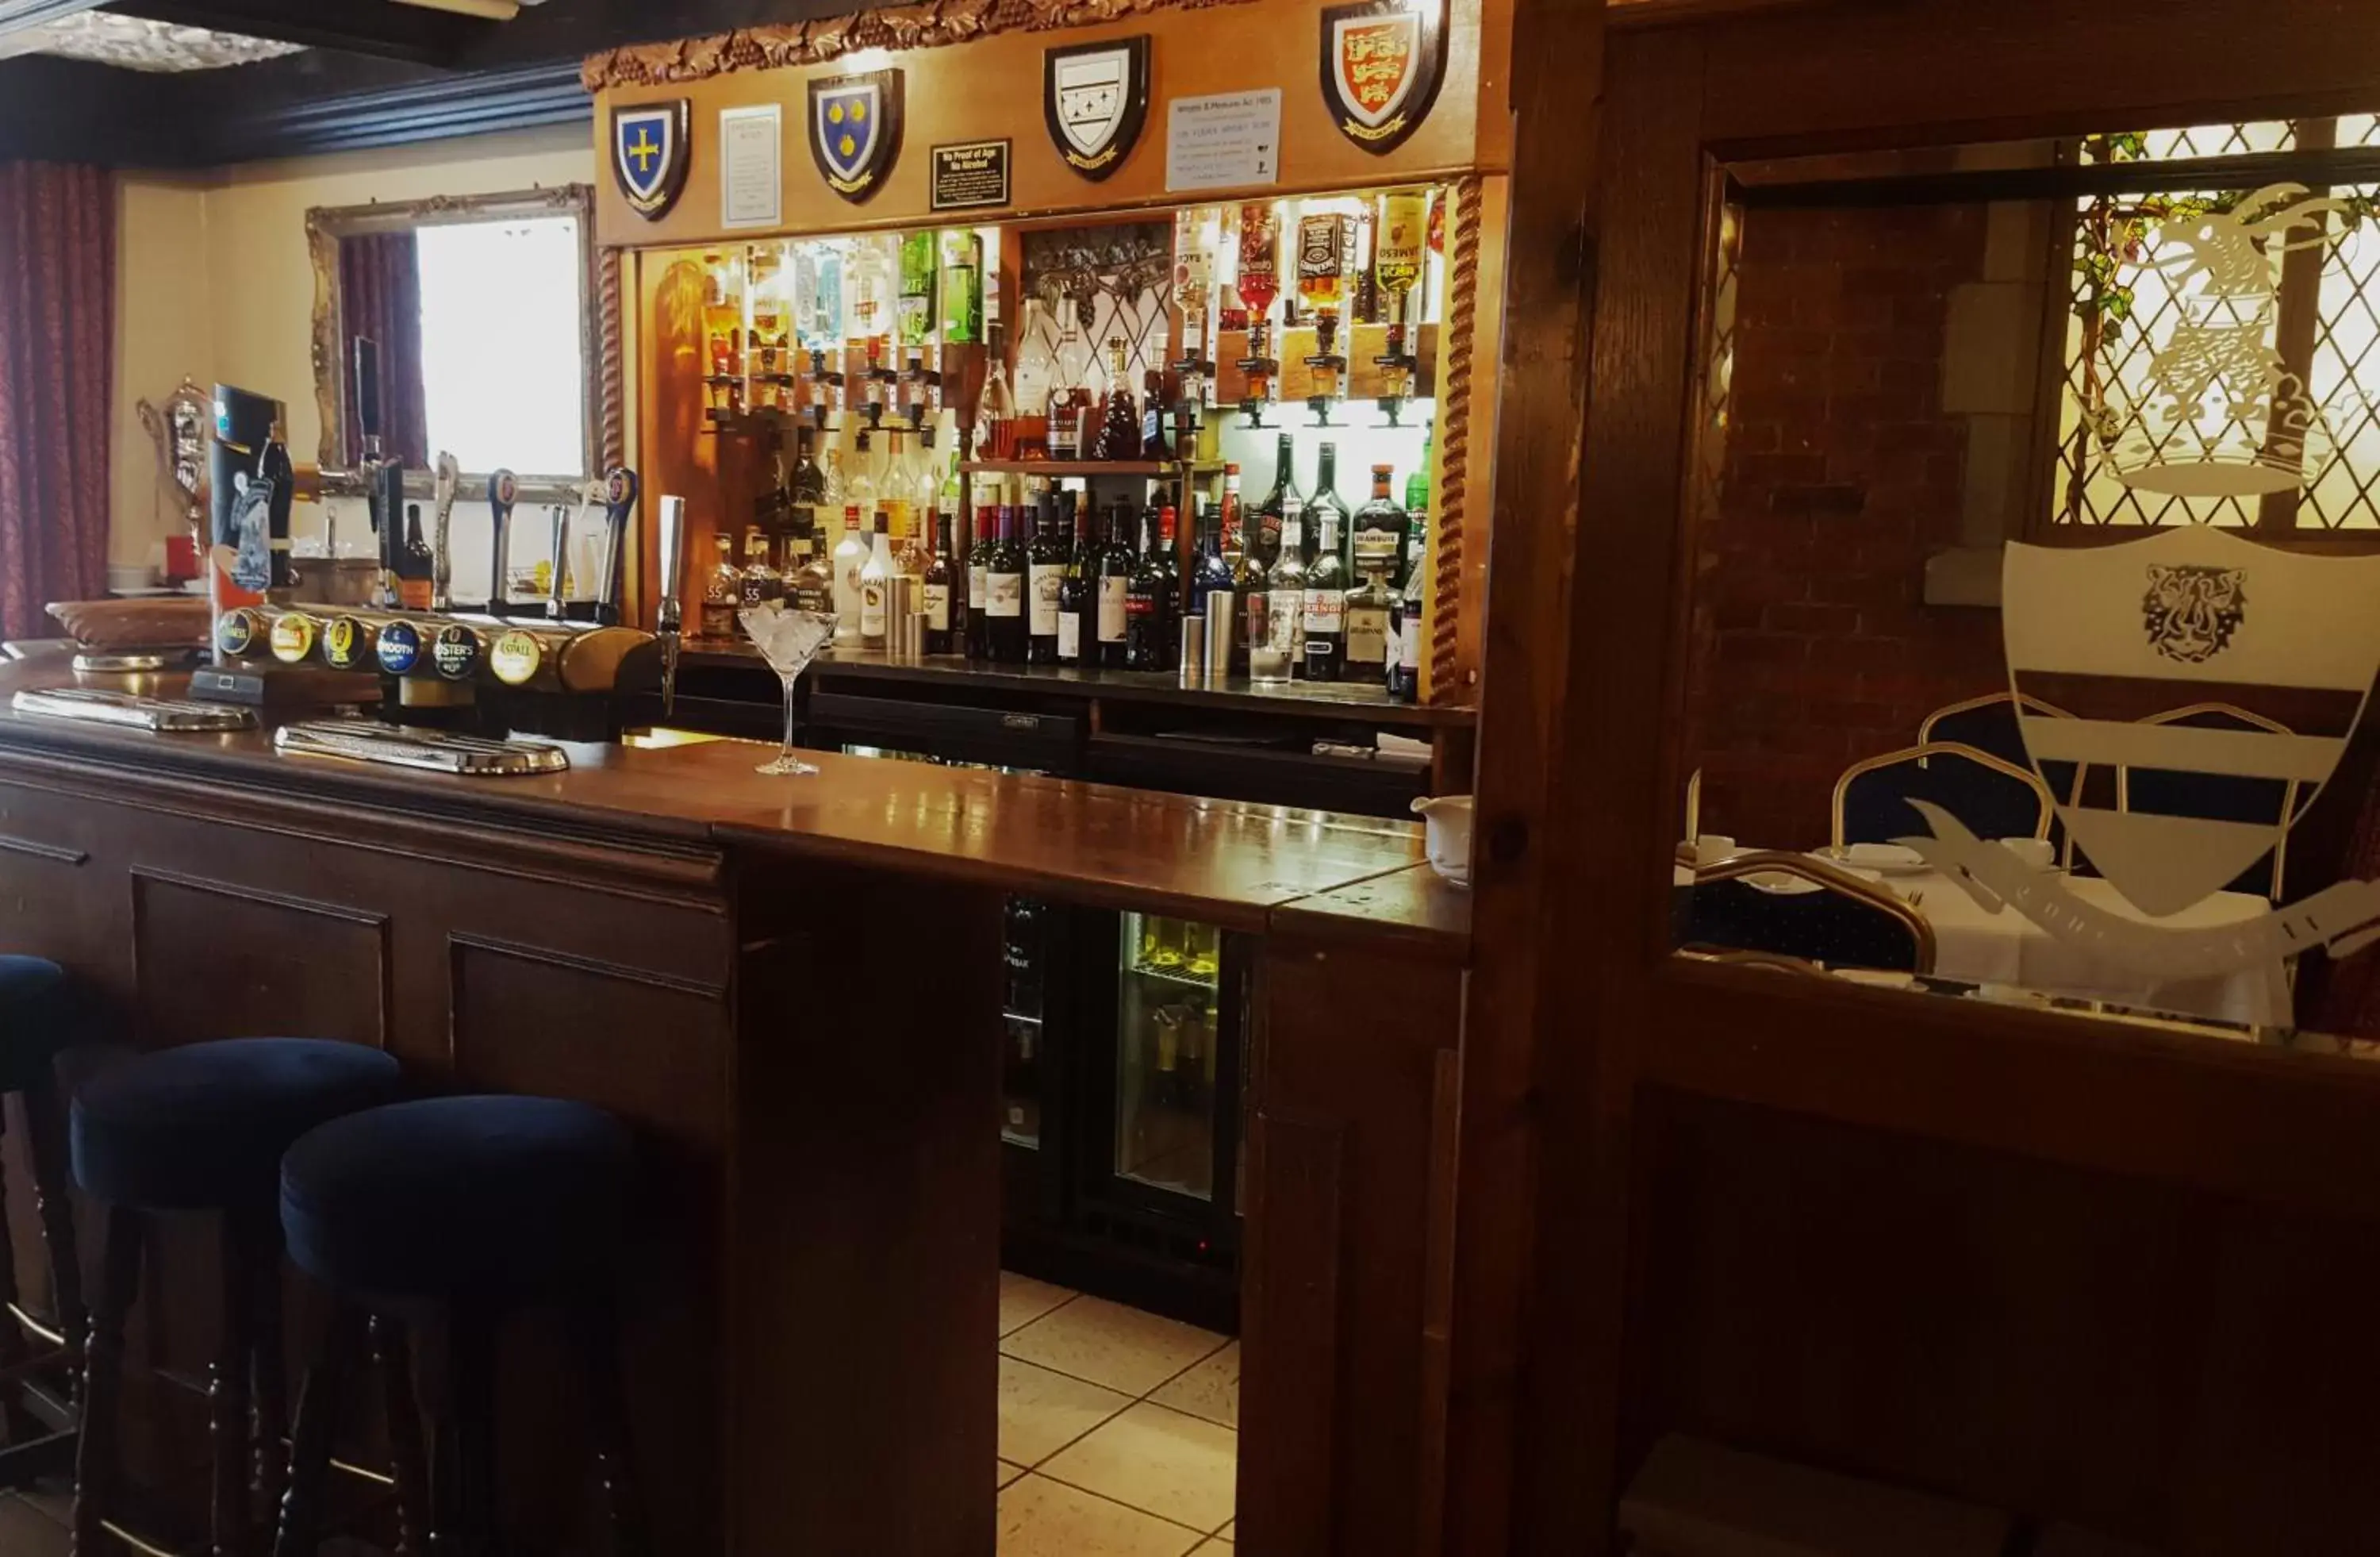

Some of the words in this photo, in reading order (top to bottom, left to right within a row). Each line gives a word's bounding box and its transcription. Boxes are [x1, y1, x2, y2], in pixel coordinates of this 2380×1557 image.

[942, 153, 953, 162] No
[954, 151, 973, 160] Proof
[973, 148, 981, 159] of
[982, 148, 996, 159] Age
[950, 161, 961, 171] No
[962, 158, 988, 169] Alcohol
